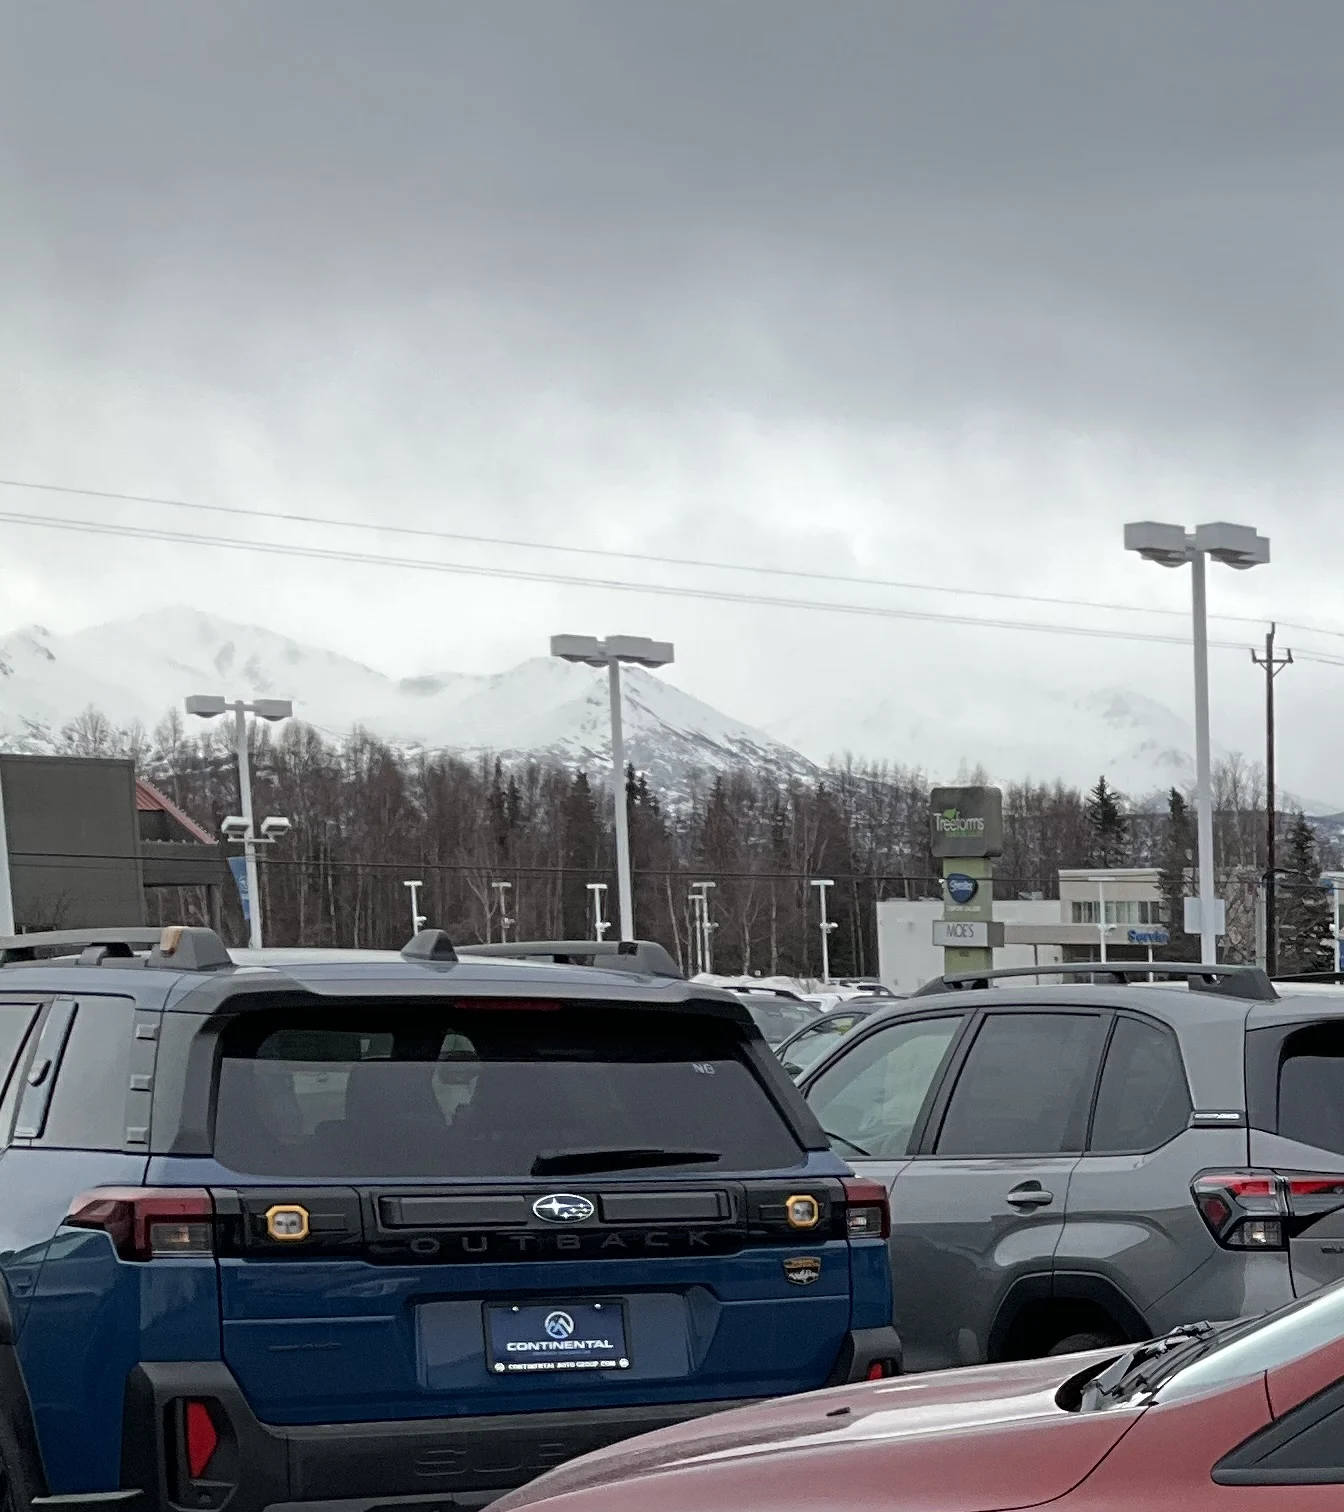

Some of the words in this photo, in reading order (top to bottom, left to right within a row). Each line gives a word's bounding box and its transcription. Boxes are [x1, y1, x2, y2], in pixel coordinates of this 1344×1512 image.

[933, 808, 985, 832] Treeforms
[408, 1230, 711, 1256] OUTBACK
[506, 1339, 614, 1352] CONTINENTAL
